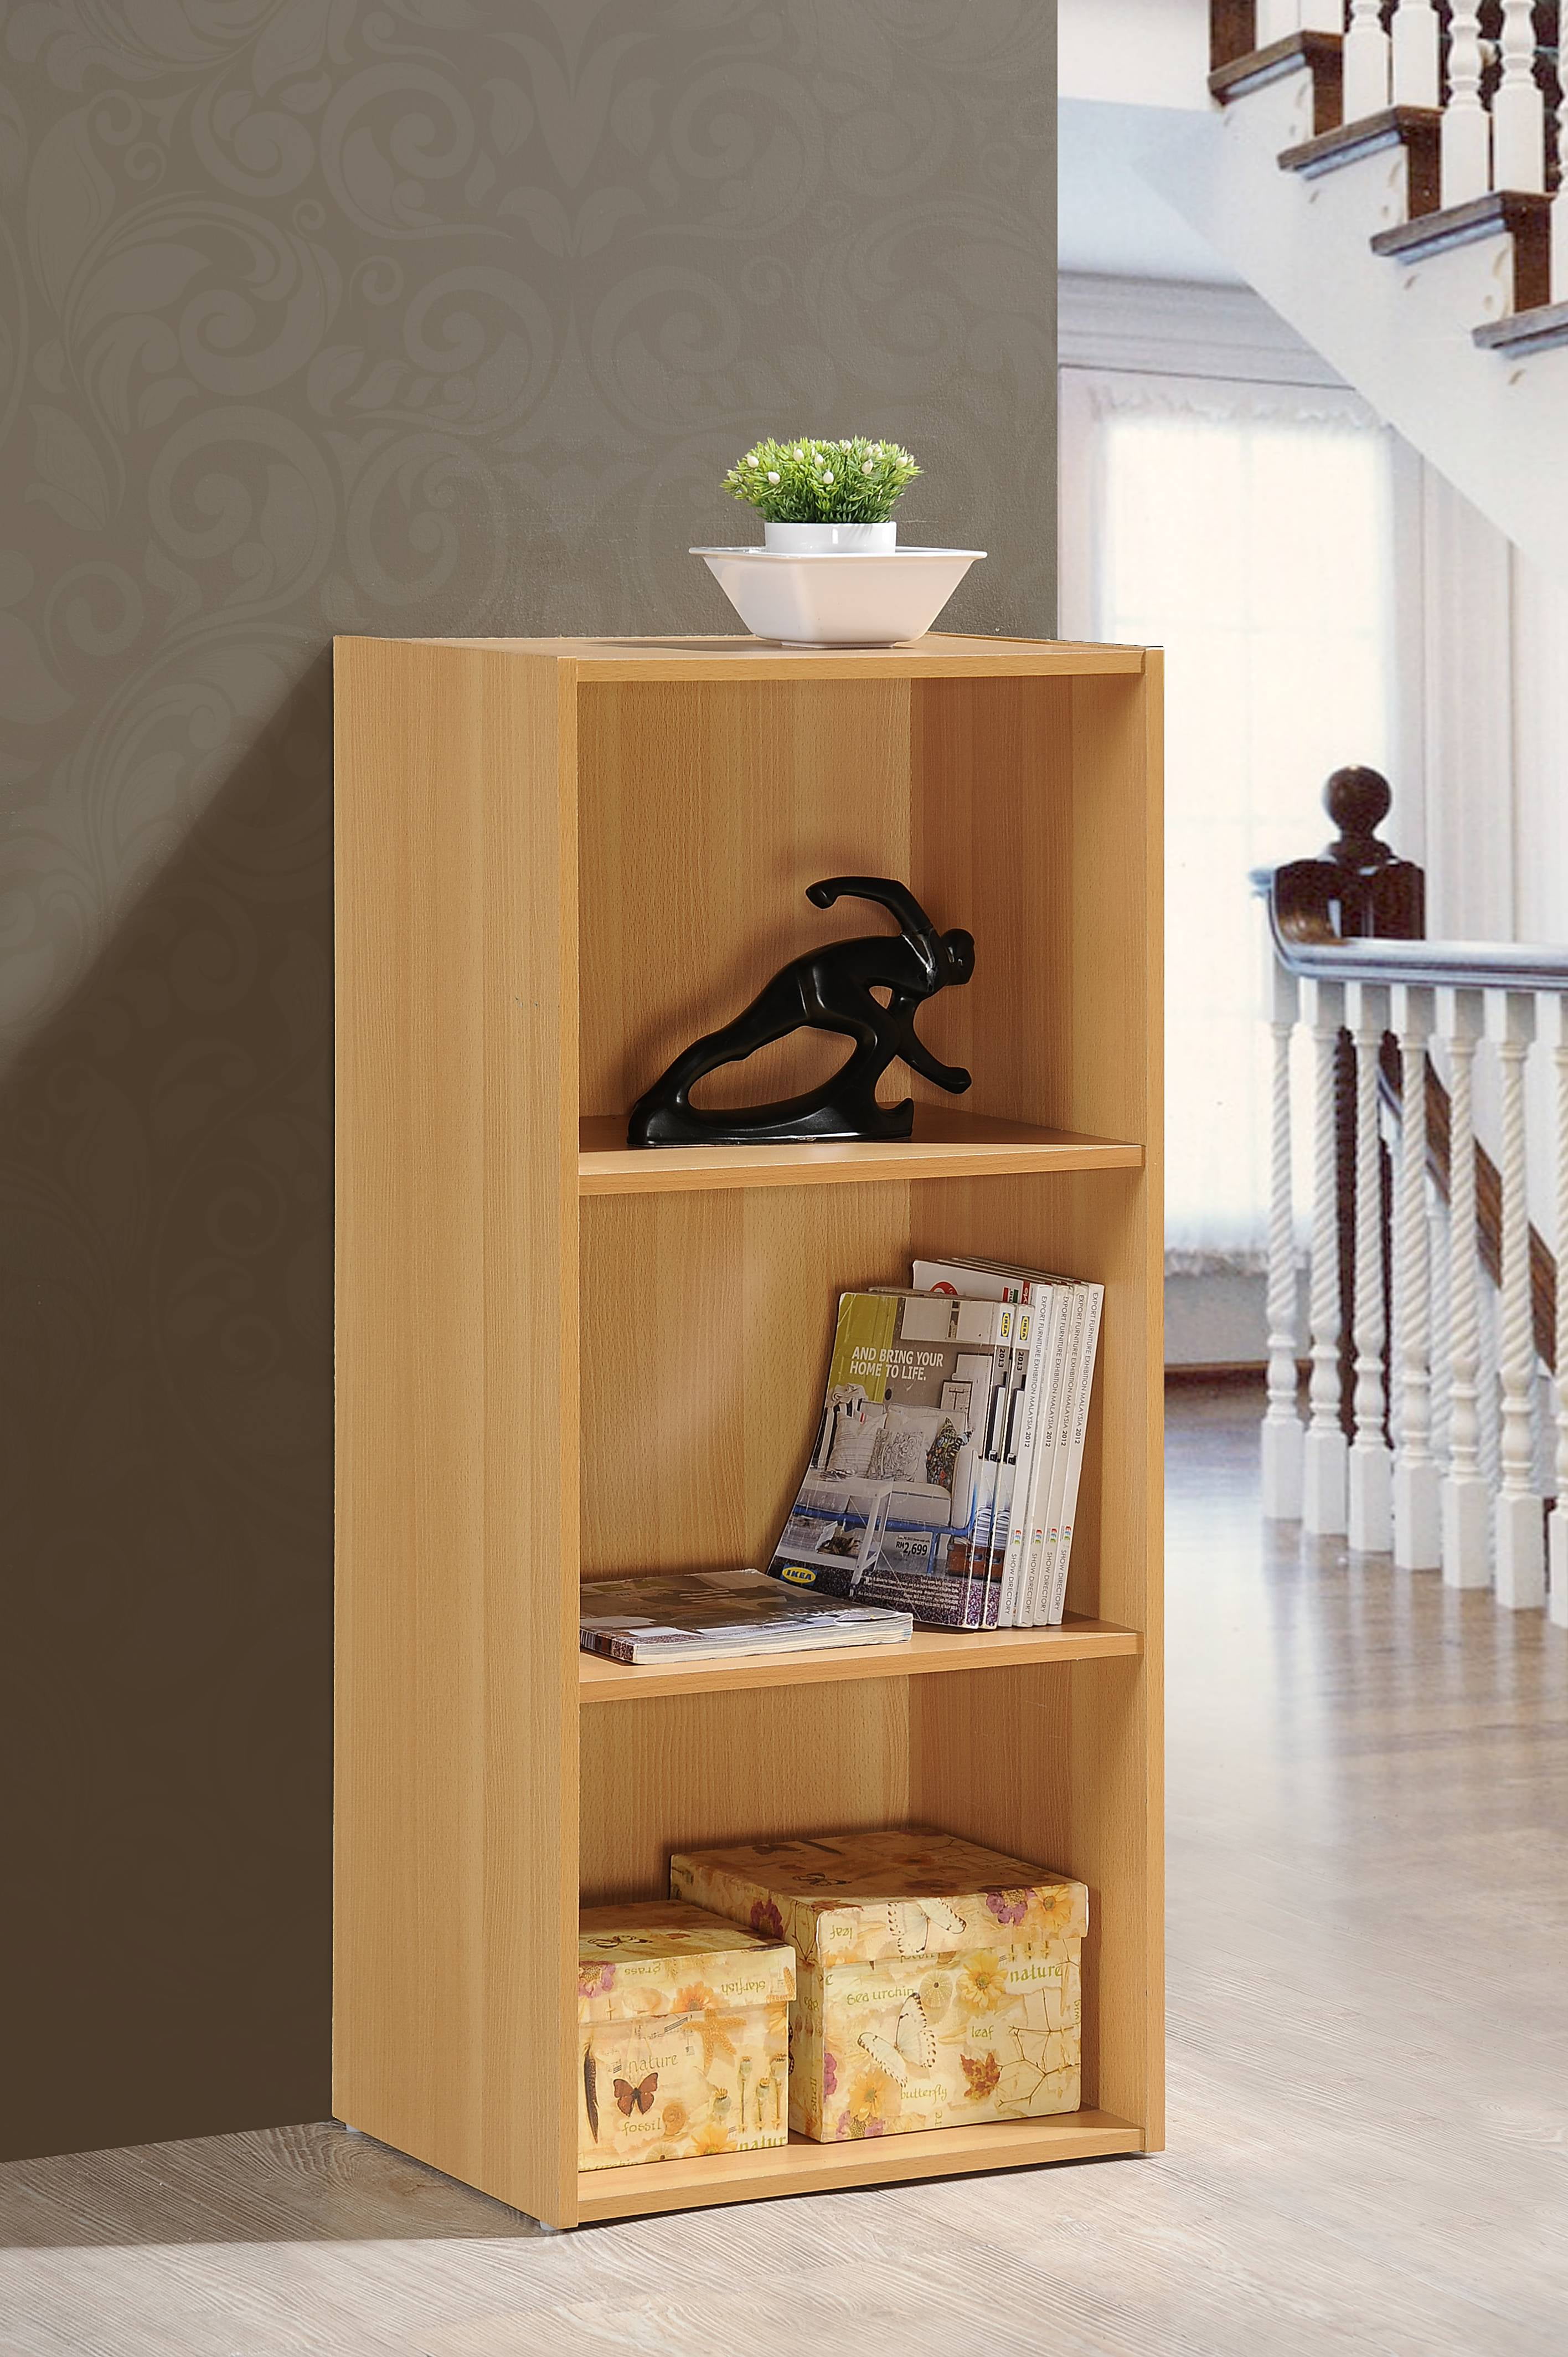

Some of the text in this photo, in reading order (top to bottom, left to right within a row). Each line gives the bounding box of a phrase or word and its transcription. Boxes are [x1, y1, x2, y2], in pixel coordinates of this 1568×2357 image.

[1039, 1296, 1048, 1321] EXPORT
[1060, 1296, 1069, 1322] EXPORT
[1076, 1295, 1085, 1321] EXPORT
[1090, 1293, 1098, 1319] EXPORT
[1035, 1323, 1045, 1357] FURNITURE
[1056, 1322, 1066, 1357] FURNITURE
[1072, 1322, 1081, 1356] FURNITURE
[1086, 1320, 1095, 1354] FURNITURE
[849, 1361, 926, 1381] HOME TO LIFE.
[852, 1346, 943, 1367] AND BRING YOUR
[1031, 1358, 1040, 1394] EXHIBITION
[1053, 1358, 1061, 1394] EXHIBITION
[1067, 1358, 1077, 1393] EXHIBITION
[1081, 1356, 1091, 1391] EXHIBITION
[1027, 1396, 1035, 1430] MALAYSIA
[1048, 1396, 1056, 1429] MALAYSIA
[1064, 1394, 1072, 1428] MALAYSIA
[1077, 1392, 1086, 1427] MALAYSIA
[786, 1569, 812, 1581] IKEA
[1008, 1553, 1017, 1575] SHOW
[1005, 1577, 1014, 1615] DIRECTORY
[1025, 1576, 1034, 1614] DIRECTORY
[1041, 1575, 1050, 1613] DIRECTORY
[1055, 1572, 1064, 1610] DIRECTORY
[624, 1962, 662, 1975] grass
[1010, 1964, 1062, 1983] nature
[721, 1978, 766, 1996] starfish
[873, 1986, 914, 2000] urchin
[972, 2025, 994, 2040] leaf
[628, 2055, 678, 2073] nature
[900, 2084, 948, 2103] butterfly
[622, 2118, 662, 2136] fossil
